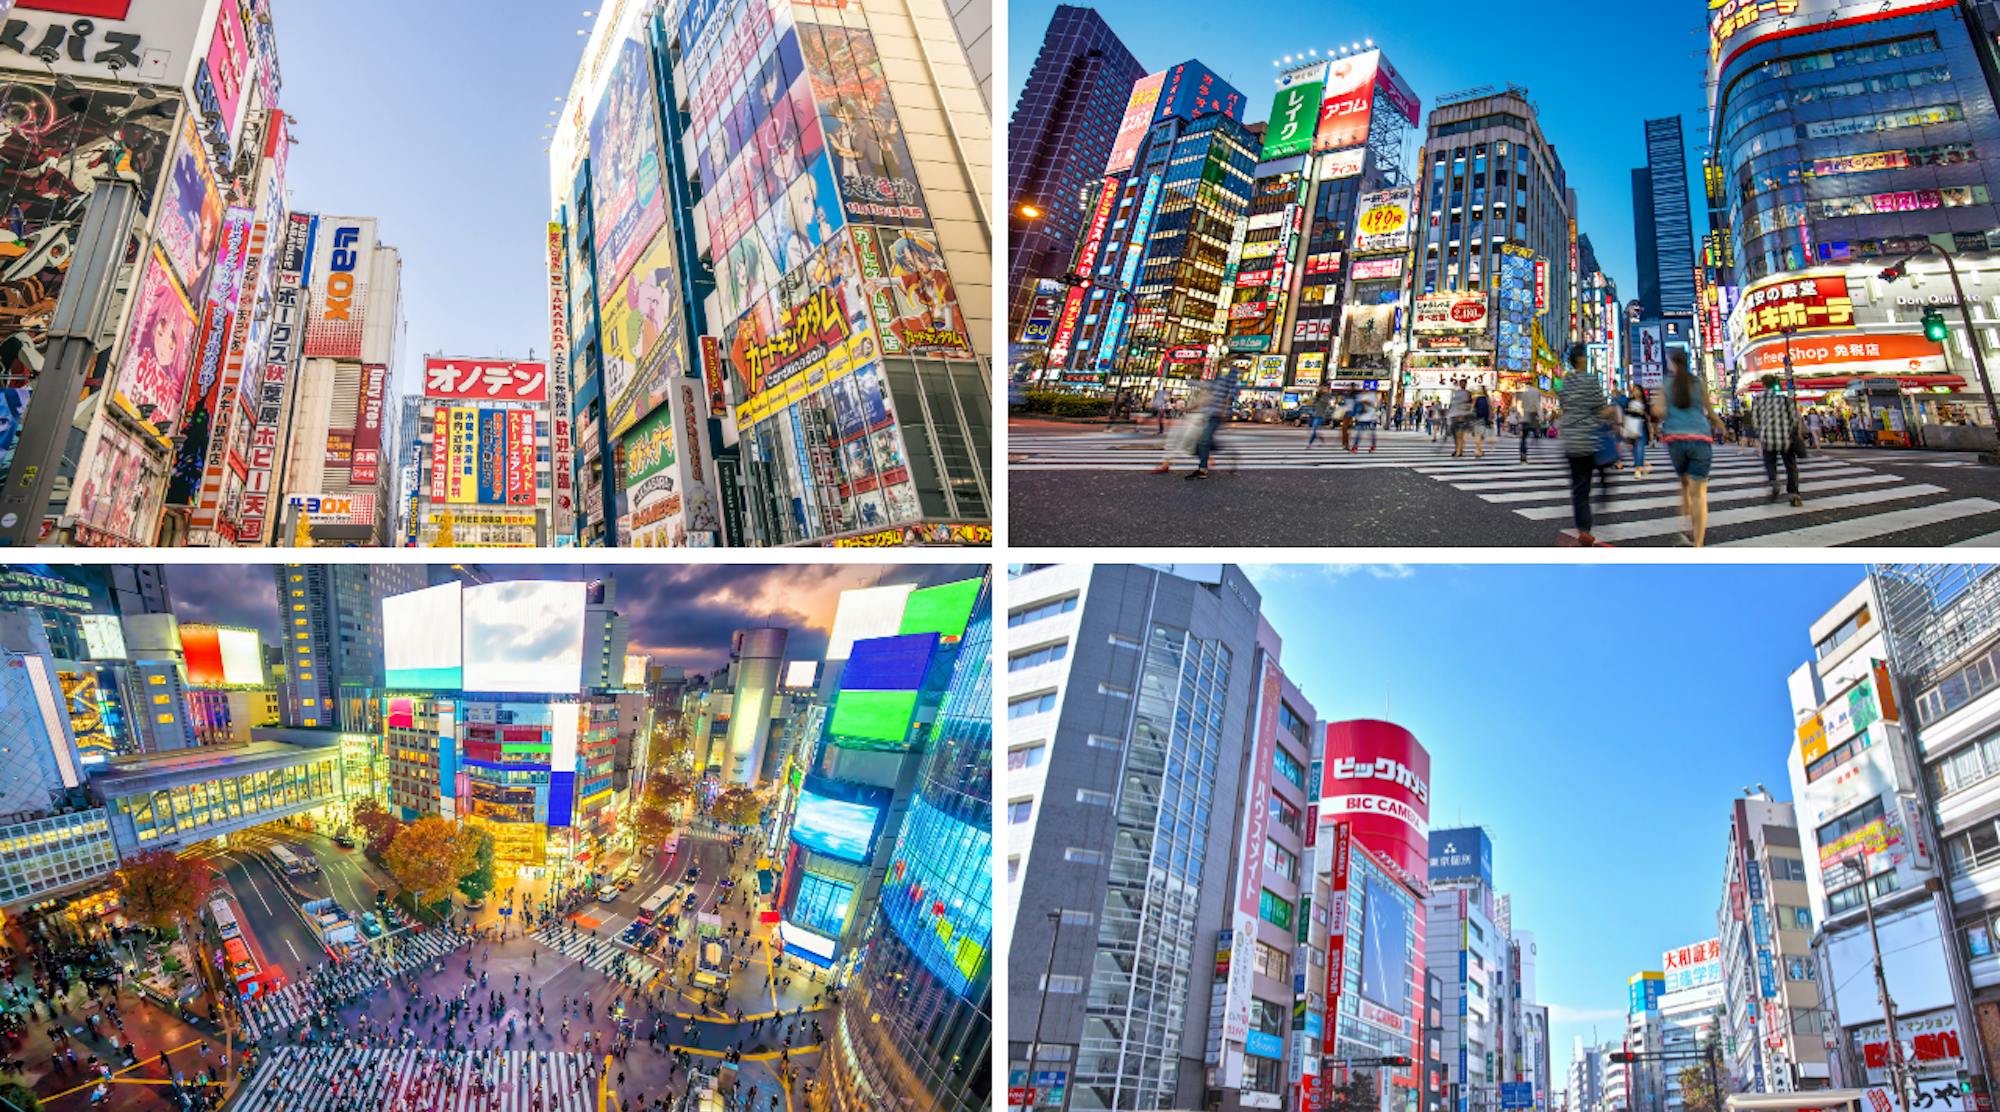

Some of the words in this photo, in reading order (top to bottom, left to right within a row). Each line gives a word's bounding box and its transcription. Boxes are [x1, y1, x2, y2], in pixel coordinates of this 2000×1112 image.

[1280, 91, 1304, 141] レイク
[1324, 99, 1368, 120] アコム
[283, 215, 299, 269] PARADISE
[1927, 294, 1981, 304] Quijte
[552, 289, 565, 349] TAKARADA
[1027, 323, 1049, 337] GU
[1294, 322, 1331, 337] アコム
[744, 286, 850, 395] カードキングダム
[1788, 346, 1830, 363] Shop
[1834, 343, 1881, 358] 免税店
[428, 364, 544, 395] オノデン
[434, 437, 446, 460] TAX
[432, 463, 446, 498] FREE
[509, 452, 521, 491] エアコン
[1333, 756, 1429, 806] ビックカメラ
[1346, 797, 1374, 810] BIC
[1376, 798, 1422, 831] CAMERA
[1664, 938, 1720, 971] 大和証券
[1862, 1015, 1953, 1041] アパー・マンション
